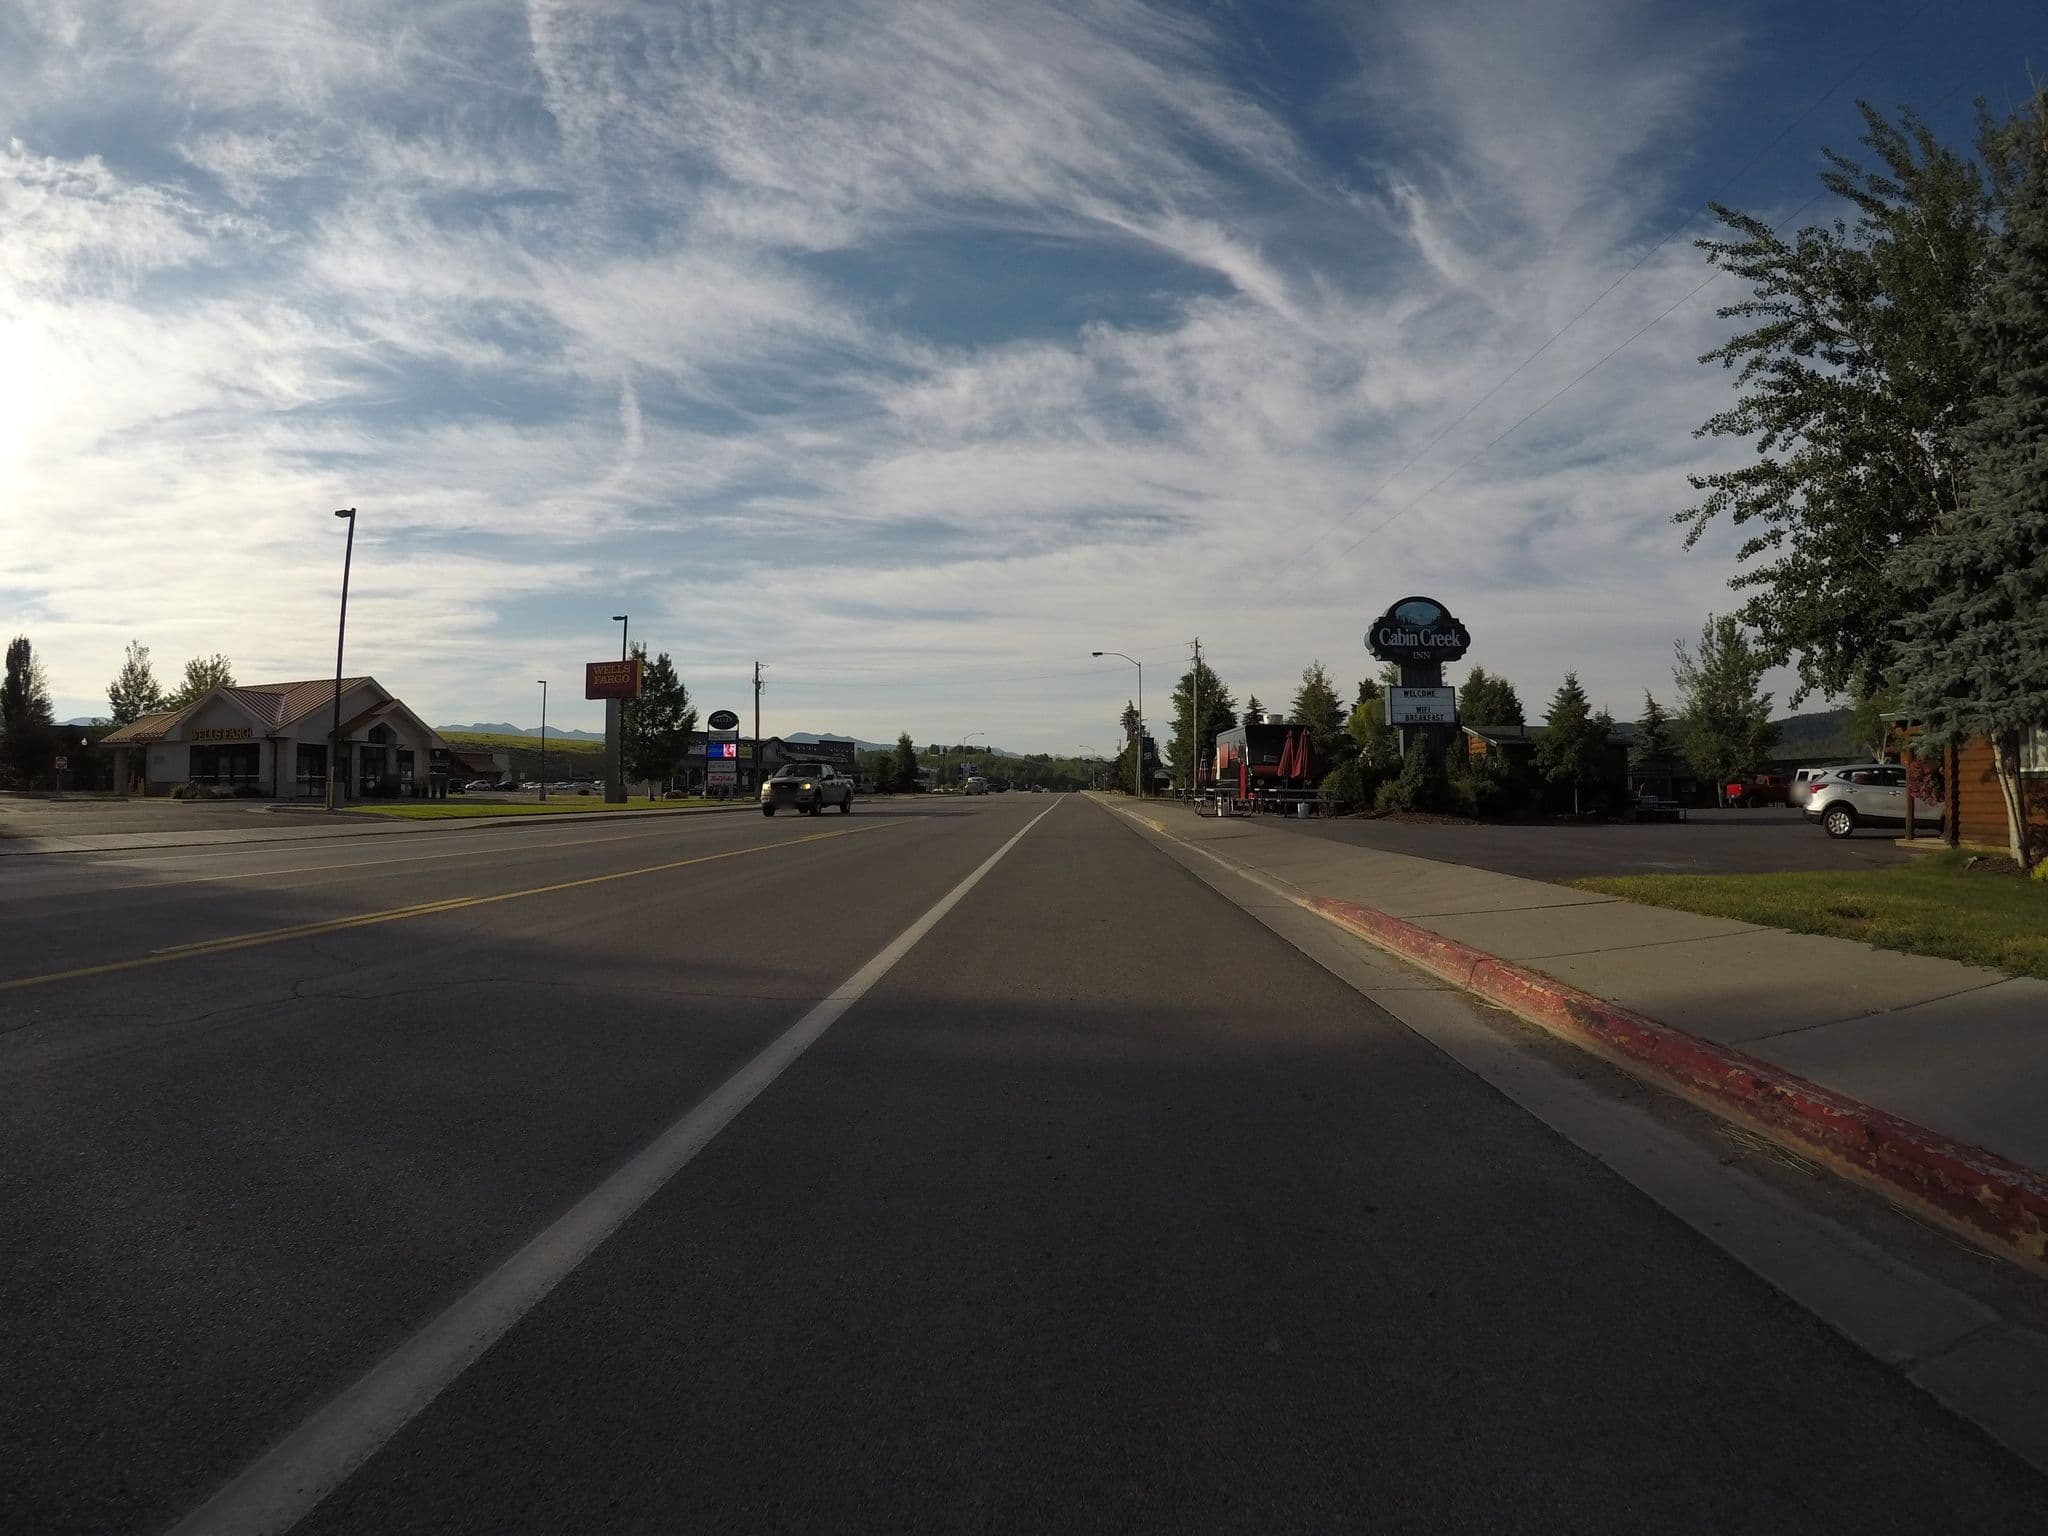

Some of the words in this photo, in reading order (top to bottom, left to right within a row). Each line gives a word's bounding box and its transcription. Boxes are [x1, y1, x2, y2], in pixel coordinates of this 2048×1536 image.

[1379, 628, 1418, 647] Cabin
[1419, 628, 1462, 647] Creek
[1413, 651, 1431, 660] INN
[593, 665, 631, 674] WELLS
[593, 674, 631, 685] FARGO
[1403, 690, 1436, 698] WELCOME
